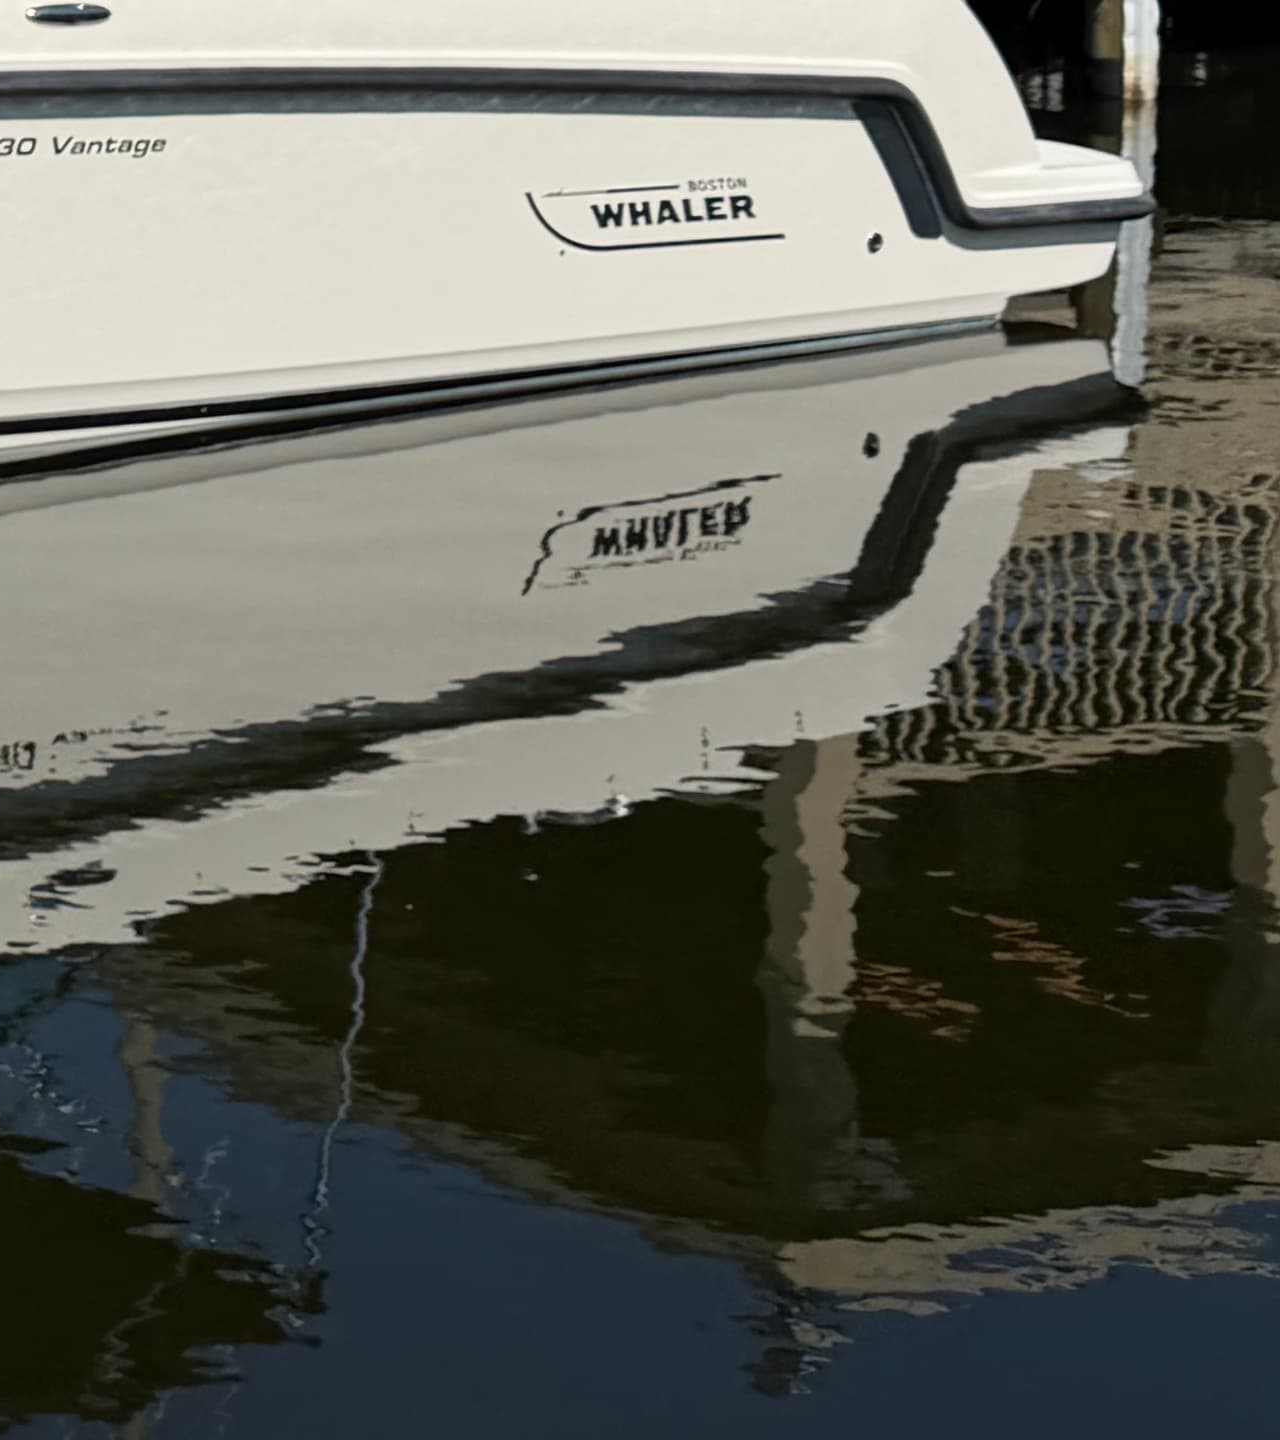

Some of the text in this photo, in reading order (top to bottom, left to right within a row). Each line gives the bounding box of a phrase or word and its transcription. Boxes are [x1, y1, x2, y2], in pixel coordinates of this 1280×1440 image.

[52, 136, 167, 158] Vantage
[687, 177, 748, 192] BOSTON
[590, 195, 756, 229] WHALER
